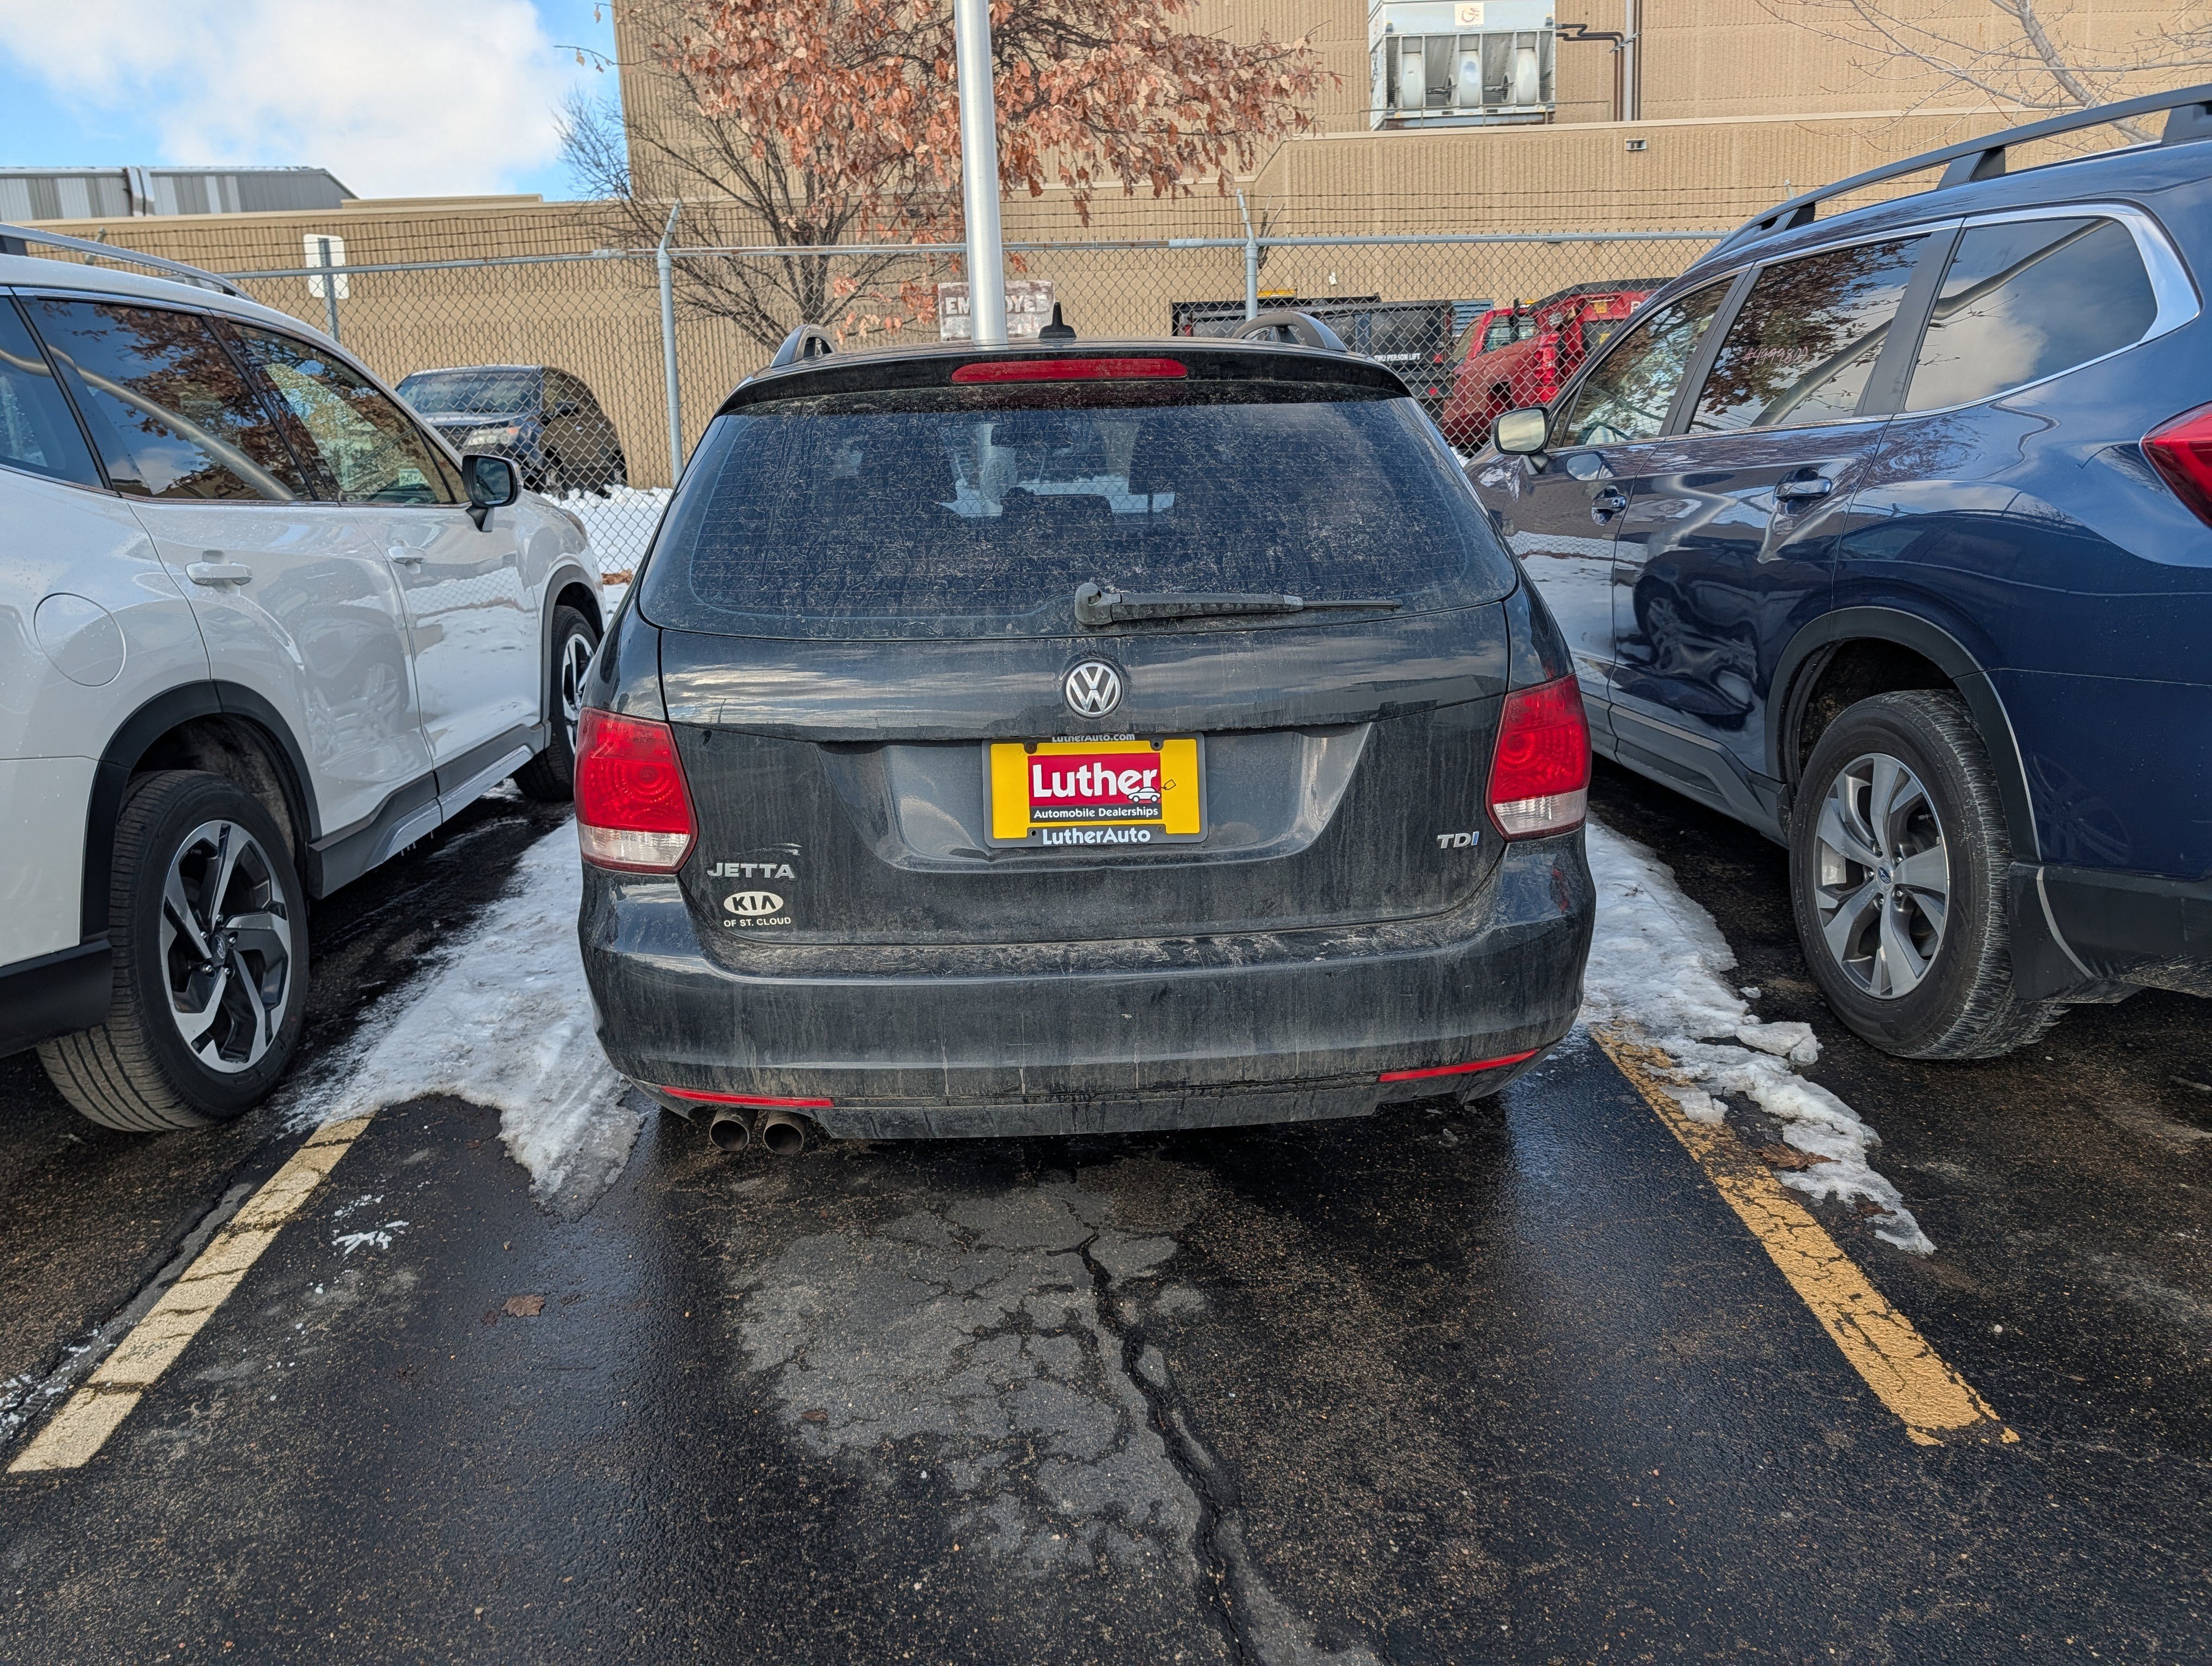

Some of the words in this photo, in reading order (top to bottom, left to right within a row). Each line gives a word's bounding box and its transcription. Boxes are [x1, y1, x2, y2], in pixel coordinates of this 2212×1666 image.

[945, 295, 1048, 314] EMOYEE
[1052, 733, 1135, 742] LutherAuto.com
[1032, 762, 1158, 798] Luther
[1033, 808, 1096, 819] Automobile
[1098, 806, 1159, 818] Dealerships
[1042, 826, 1151, 845] LutherAuto
[1436, 830, 1480, 849] TDI
[707, 862, 796, 879] JETTA
[731, 895, 777, 911] KIA
[723, 919, 737, 927] OF
[740, 919, 754, 927] ST.
[756, 917, 792, 926] CLOUD
